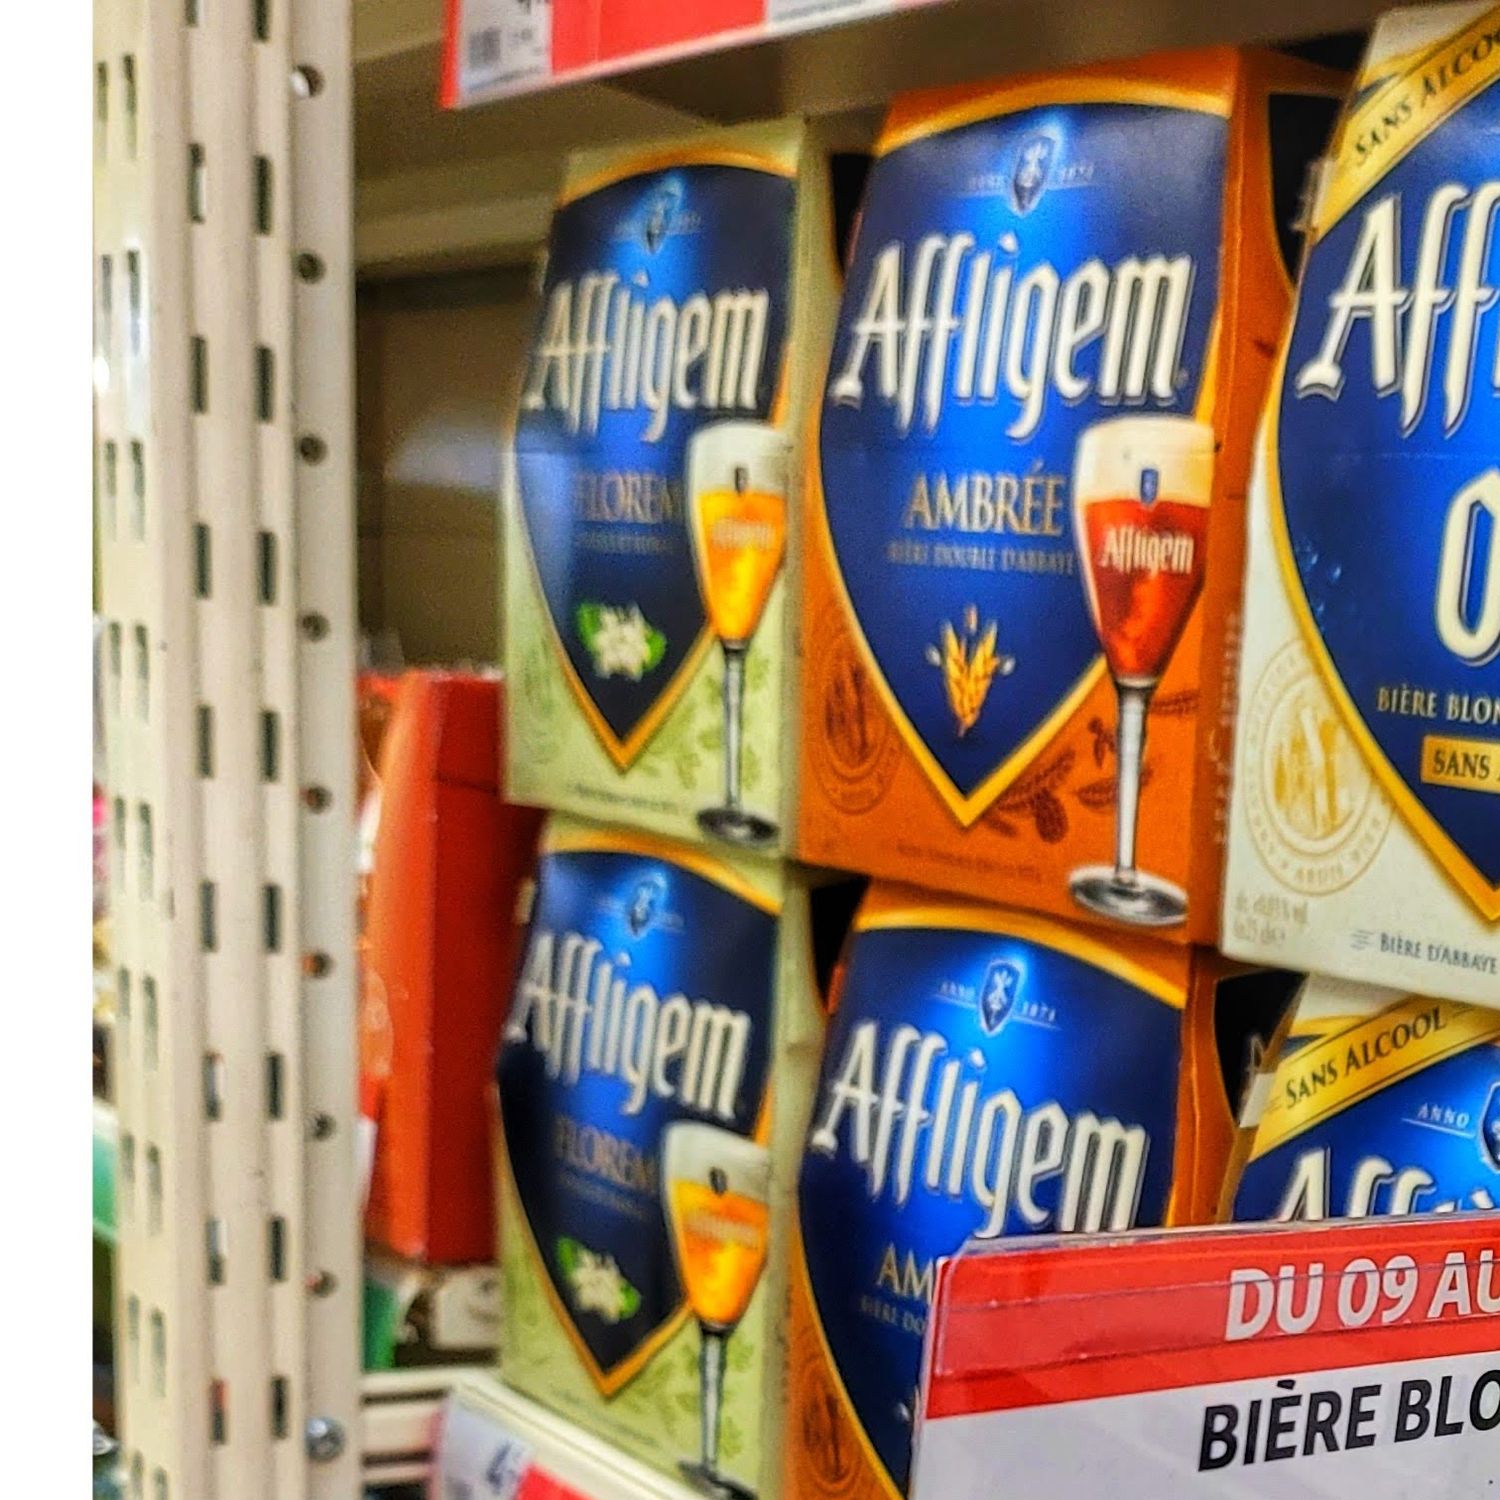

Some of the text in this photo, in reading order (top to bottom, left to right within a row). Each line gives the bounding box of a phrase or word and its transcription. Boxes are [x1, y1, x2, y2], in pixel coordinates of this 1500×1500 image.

[522, 266, 770, 442] Affligem
[830, 231, 1198, 442] Affligem
[904, 459, 1066, 537] AMBRÉE
[1375, 683, 1438, 718] BIÈRE
[1432, 746, 1490, 780] SANS
[508, 927, 753, 1120] Affligem
[1284, 1005, 1448, 1109] SANS ALCOOL
[811, 1018, 1151, 1238] Affligem
[1224, 1261, 1323, 1342] DU
[1336, 1254, 1417, 1326] 09
[1198, 1378, 1382, 1474] BIÈRE
